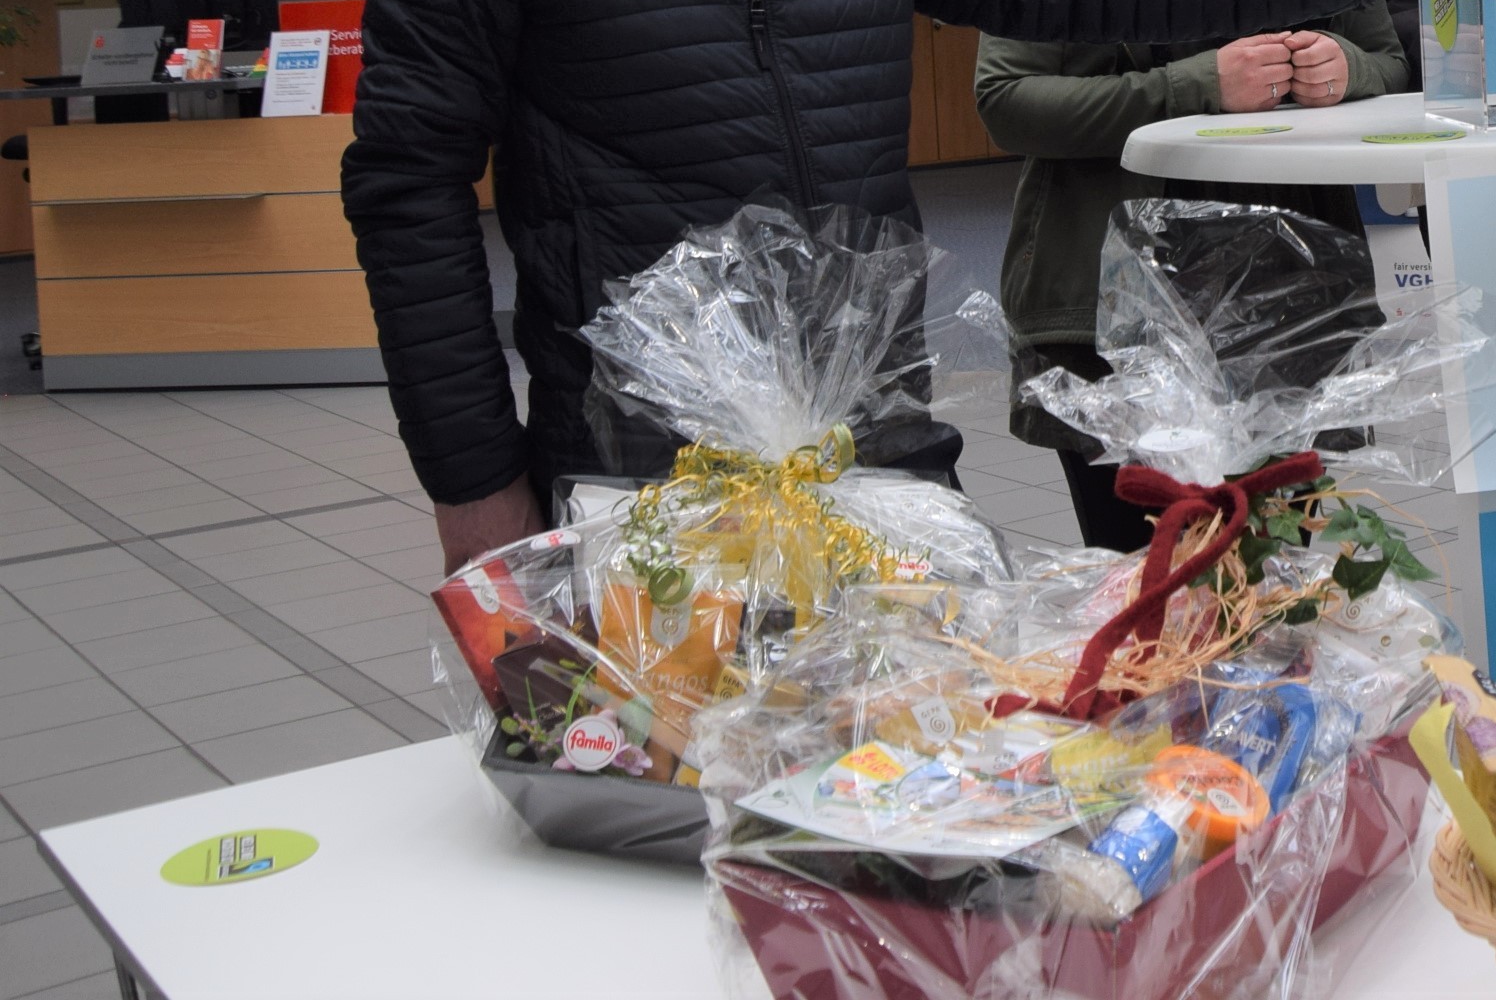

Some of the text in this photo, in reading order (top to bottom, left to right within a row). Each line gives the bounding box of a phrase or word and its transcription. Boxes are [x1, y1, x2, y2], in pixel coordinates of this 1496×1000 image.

[330, 28, 363, 41] Servi
[1394, 262, 1432, 271] fair versi
[570, 729, 614, 753] famila
